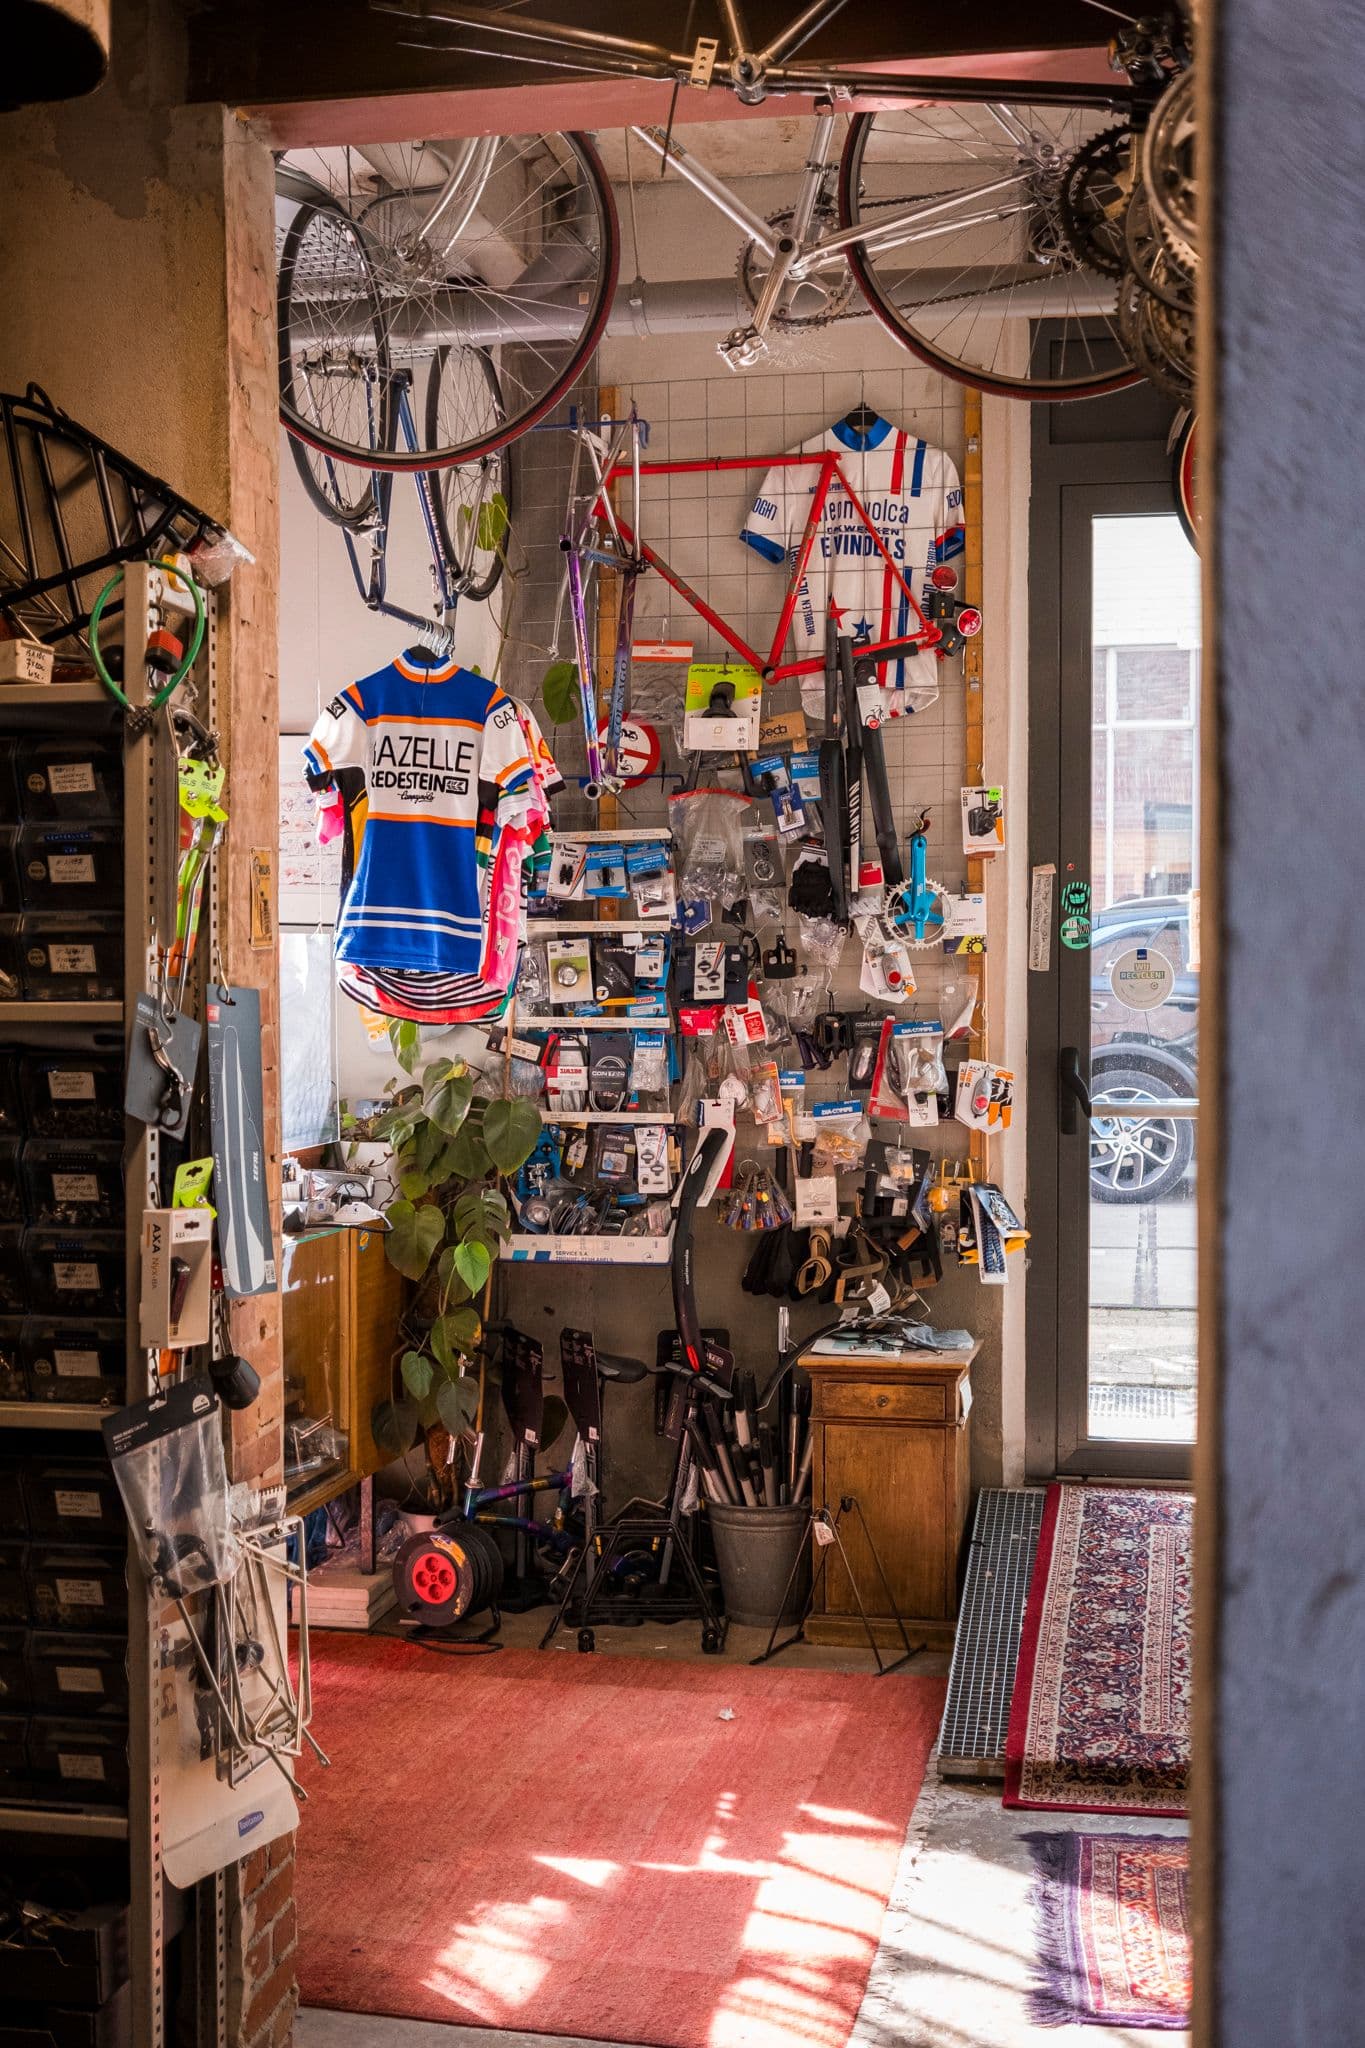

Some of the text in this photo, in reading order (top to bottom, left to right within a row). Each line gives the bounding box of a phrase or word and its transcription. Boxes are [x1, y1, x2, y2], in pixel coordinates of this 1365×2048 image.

[373, 735, 474, 773] AZELLE
[849, 780, 860, 844] CANYON
[152, 1224, 161, 1254] AXA
